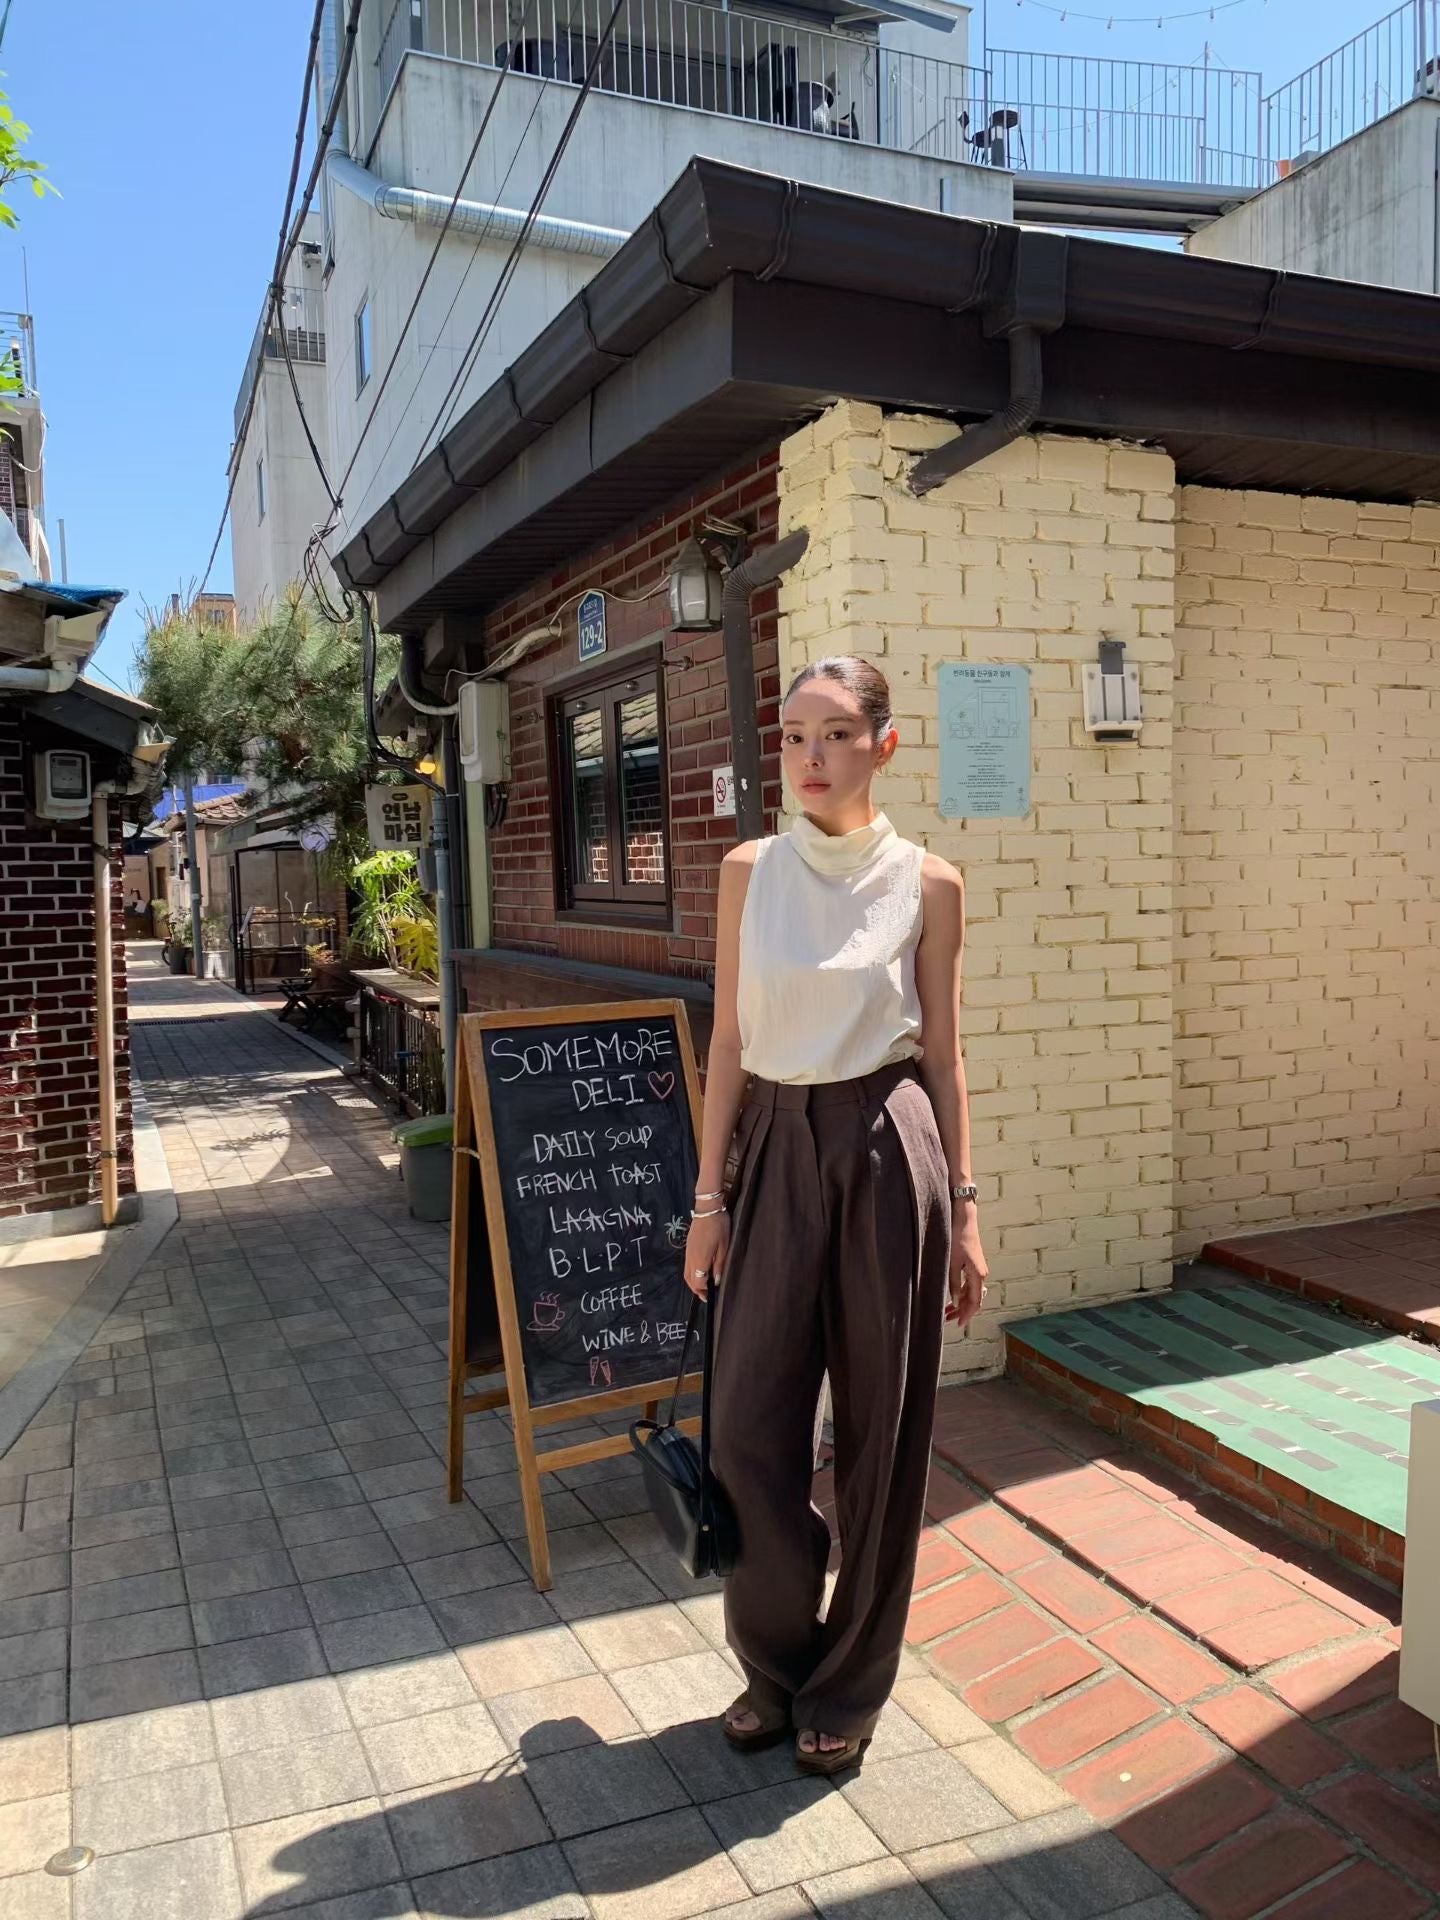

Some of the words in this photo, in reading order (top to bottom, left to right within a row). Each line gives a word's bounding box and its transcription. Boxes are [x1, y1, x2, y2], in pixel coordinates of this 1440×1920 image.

[581, 620, 603, 651] 129-2
[382, 801, 421, 822] 연남
[383, 822, 421, 842] 마실
[491, 1028, 672, 1082] SOMEMORE
[572, 1074, 644, 1111] DELI
[533, 1129, 596, 1163] DAILY
[604, 1125, 652, 1151] SOUP
[516, 1168, 598, 1198] FRENCH
[550, 1204, 652, 1235] LASAGNA
[581, 1284, 643, 1314] COFFEE
[582, 1326, 635, 1353] WINE
[640, 1320, 651, 1344] &
